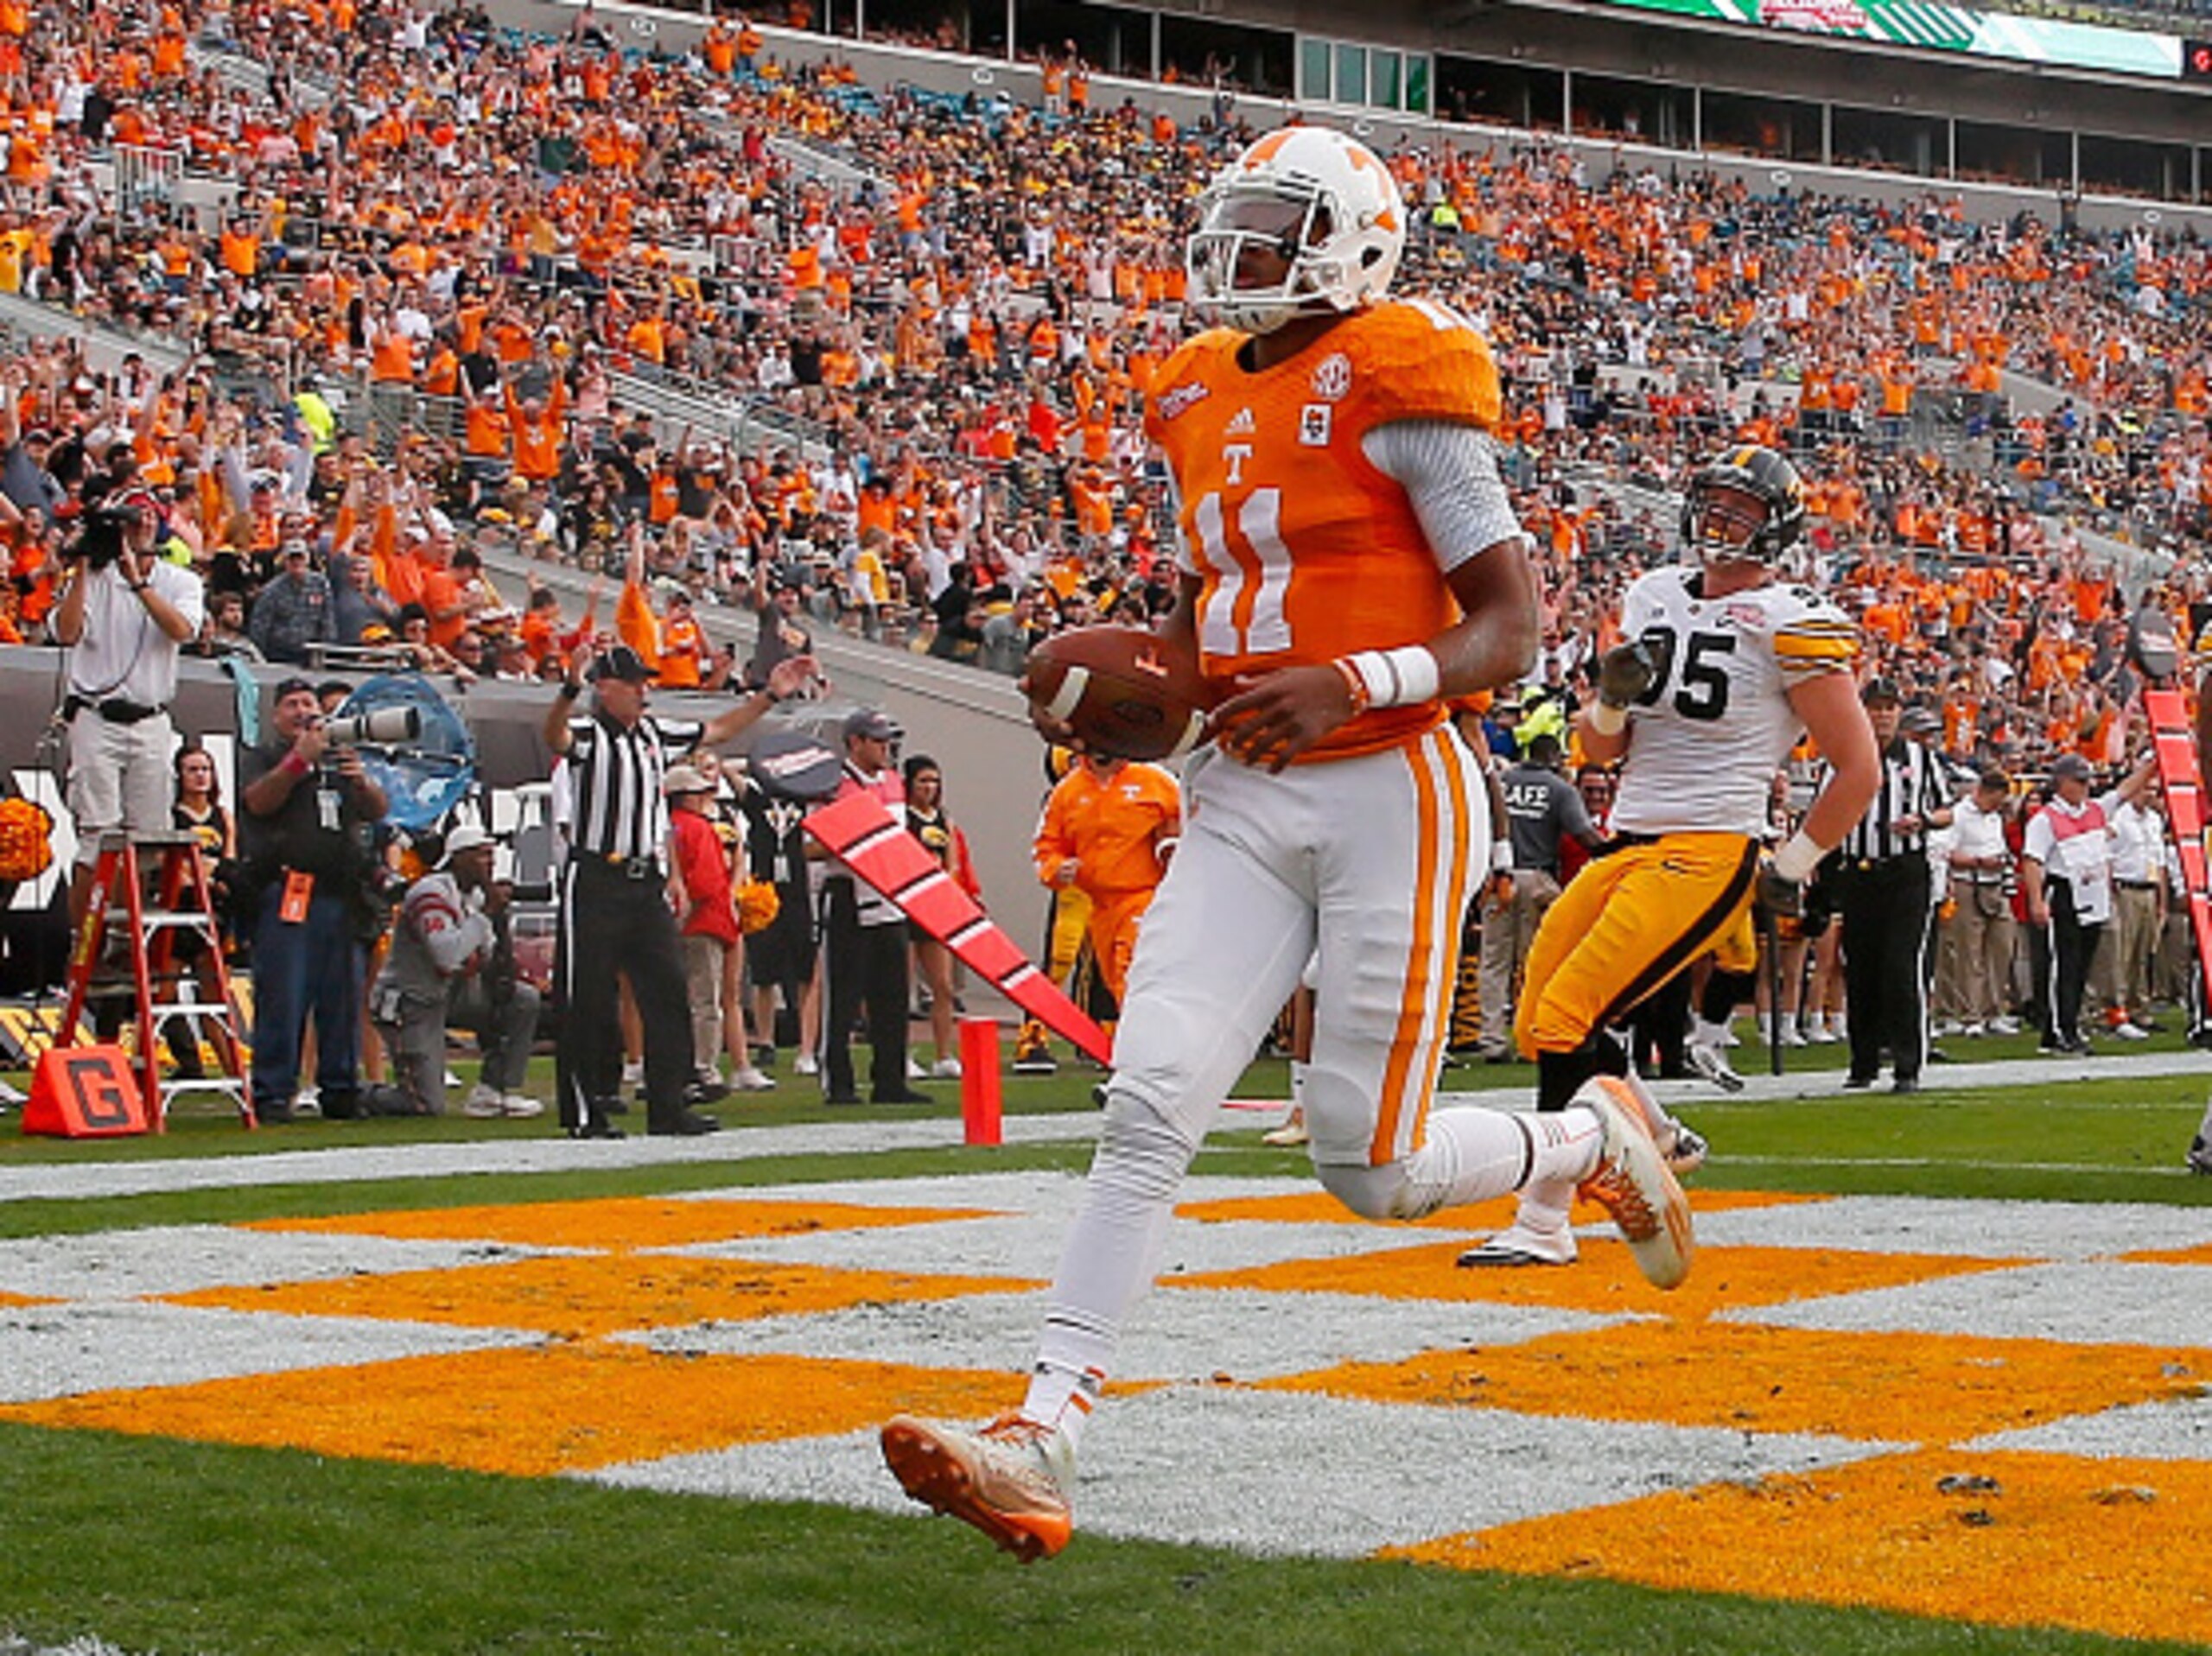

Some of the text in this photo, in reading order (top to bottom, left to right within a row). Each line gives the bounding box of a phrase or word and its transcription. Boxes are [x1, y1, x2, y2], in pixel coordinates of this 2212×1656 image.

[1222, 443, 1253, 485] T
[1195, 487, 1293, 656] 11
[1501, 784, 1549, 810] AFE
[68, 1059, 130, 1127] G
